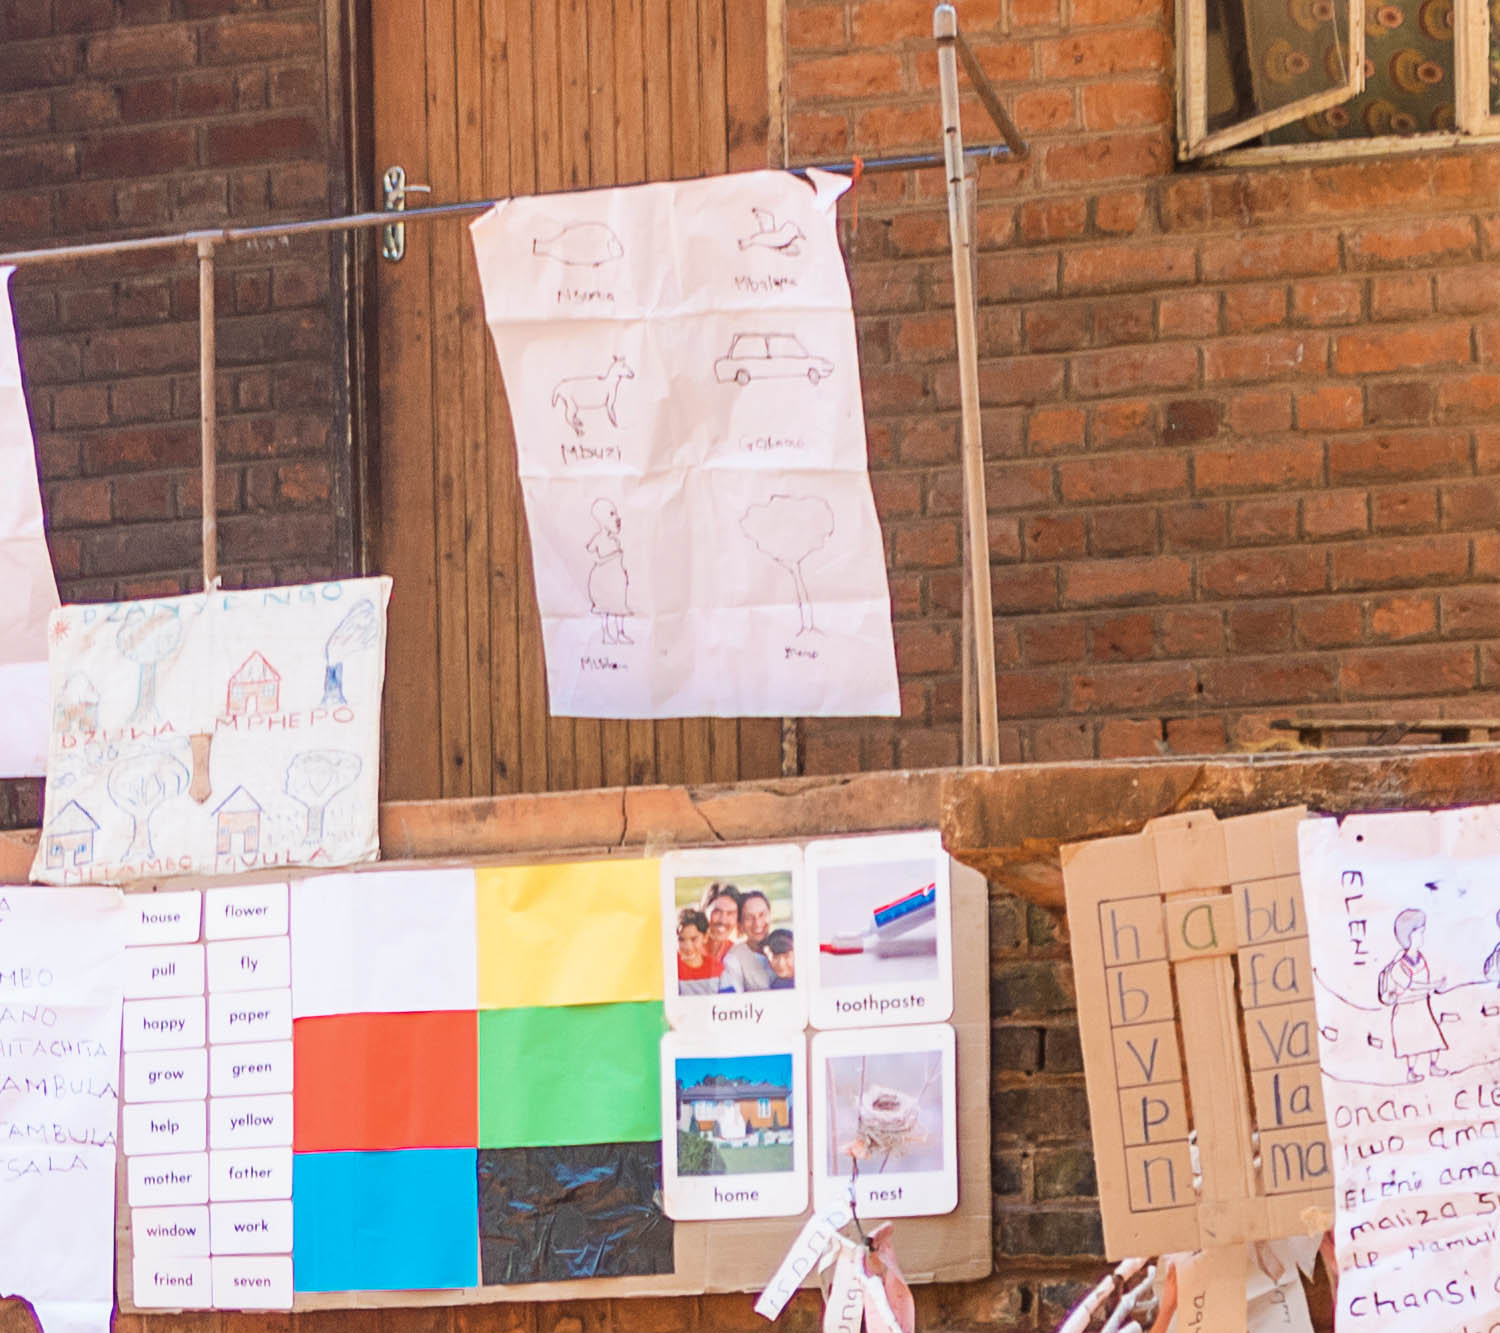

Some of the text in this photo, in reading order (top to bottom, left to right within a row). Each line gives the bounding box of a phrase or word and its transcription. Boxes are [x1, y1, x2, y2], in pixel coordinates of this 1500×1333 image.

[141, 911, 181, 924] house
[224, 904, 269, 918] flower
[1110, 887, 1297, 961] h a bu
[151, 962, 176, 980] pull
[240, 955, 258, 972] fly
[1117, 951, 1301, 1024] b fa
[835, 991, 926, 1015] toothpaste
[229, 1009, 271, 1024] paper
[711, 1002, 765, 1024] family
[143, 1016, 186, 1032] happy
[1257, 1019, 1312, 1065] va
[148, 1069, 184, 1085] grow
[231, 1062, 272, 1077] green
[150, 1119, 180, 1135] help
[229, 1112, 274, 1131] yellow
[144, 1171, 193, 1185] mother
[228, 1165, 273, 1180] father
[1143, 1139, 1331, 1205] n ma
[714, 1186, 760, 1202] home
[869, 1187, 903, 1201] nest
[146, 1223, 197, 1237] window
[233, 1218, 269, 1233] work
[153, 1271, 194, 1286] friend
[233, 1275, 271, 1287] seven
